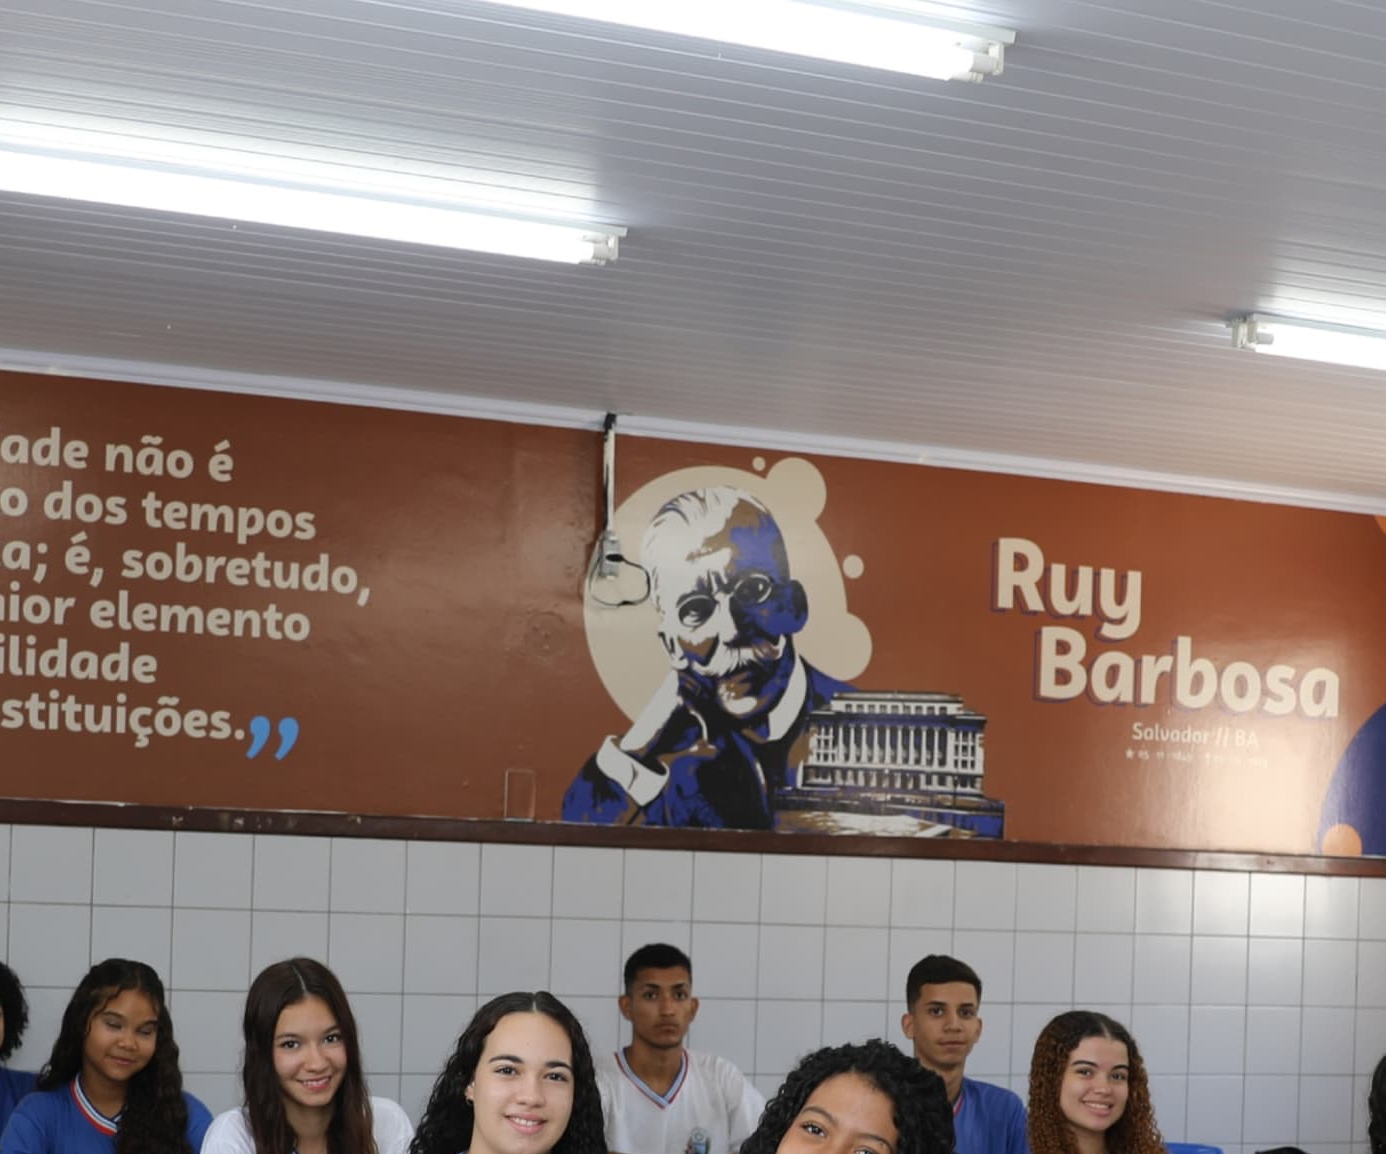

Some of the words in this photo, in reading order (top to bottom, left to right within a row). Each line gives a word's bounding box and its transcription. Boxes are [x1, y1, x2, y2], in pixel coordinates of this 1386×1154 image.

[105, 434, 194, 479] não
[208, 439, 234, 483] é
[43, 480, 128, 526] dos
[141, 490, 316, 545] tempos
[65, 530, 104, 588] é,
[121, 541, 371, 608] sobretudo,
[996, 537, 1143, 640] Ruy
[90, 589, 311, 642] elemento
[1039, 625, 1340, 719] Barbosa
[1132, 721, 1210, 745] Salvador
[1235, 728, 1260, 747] BA
